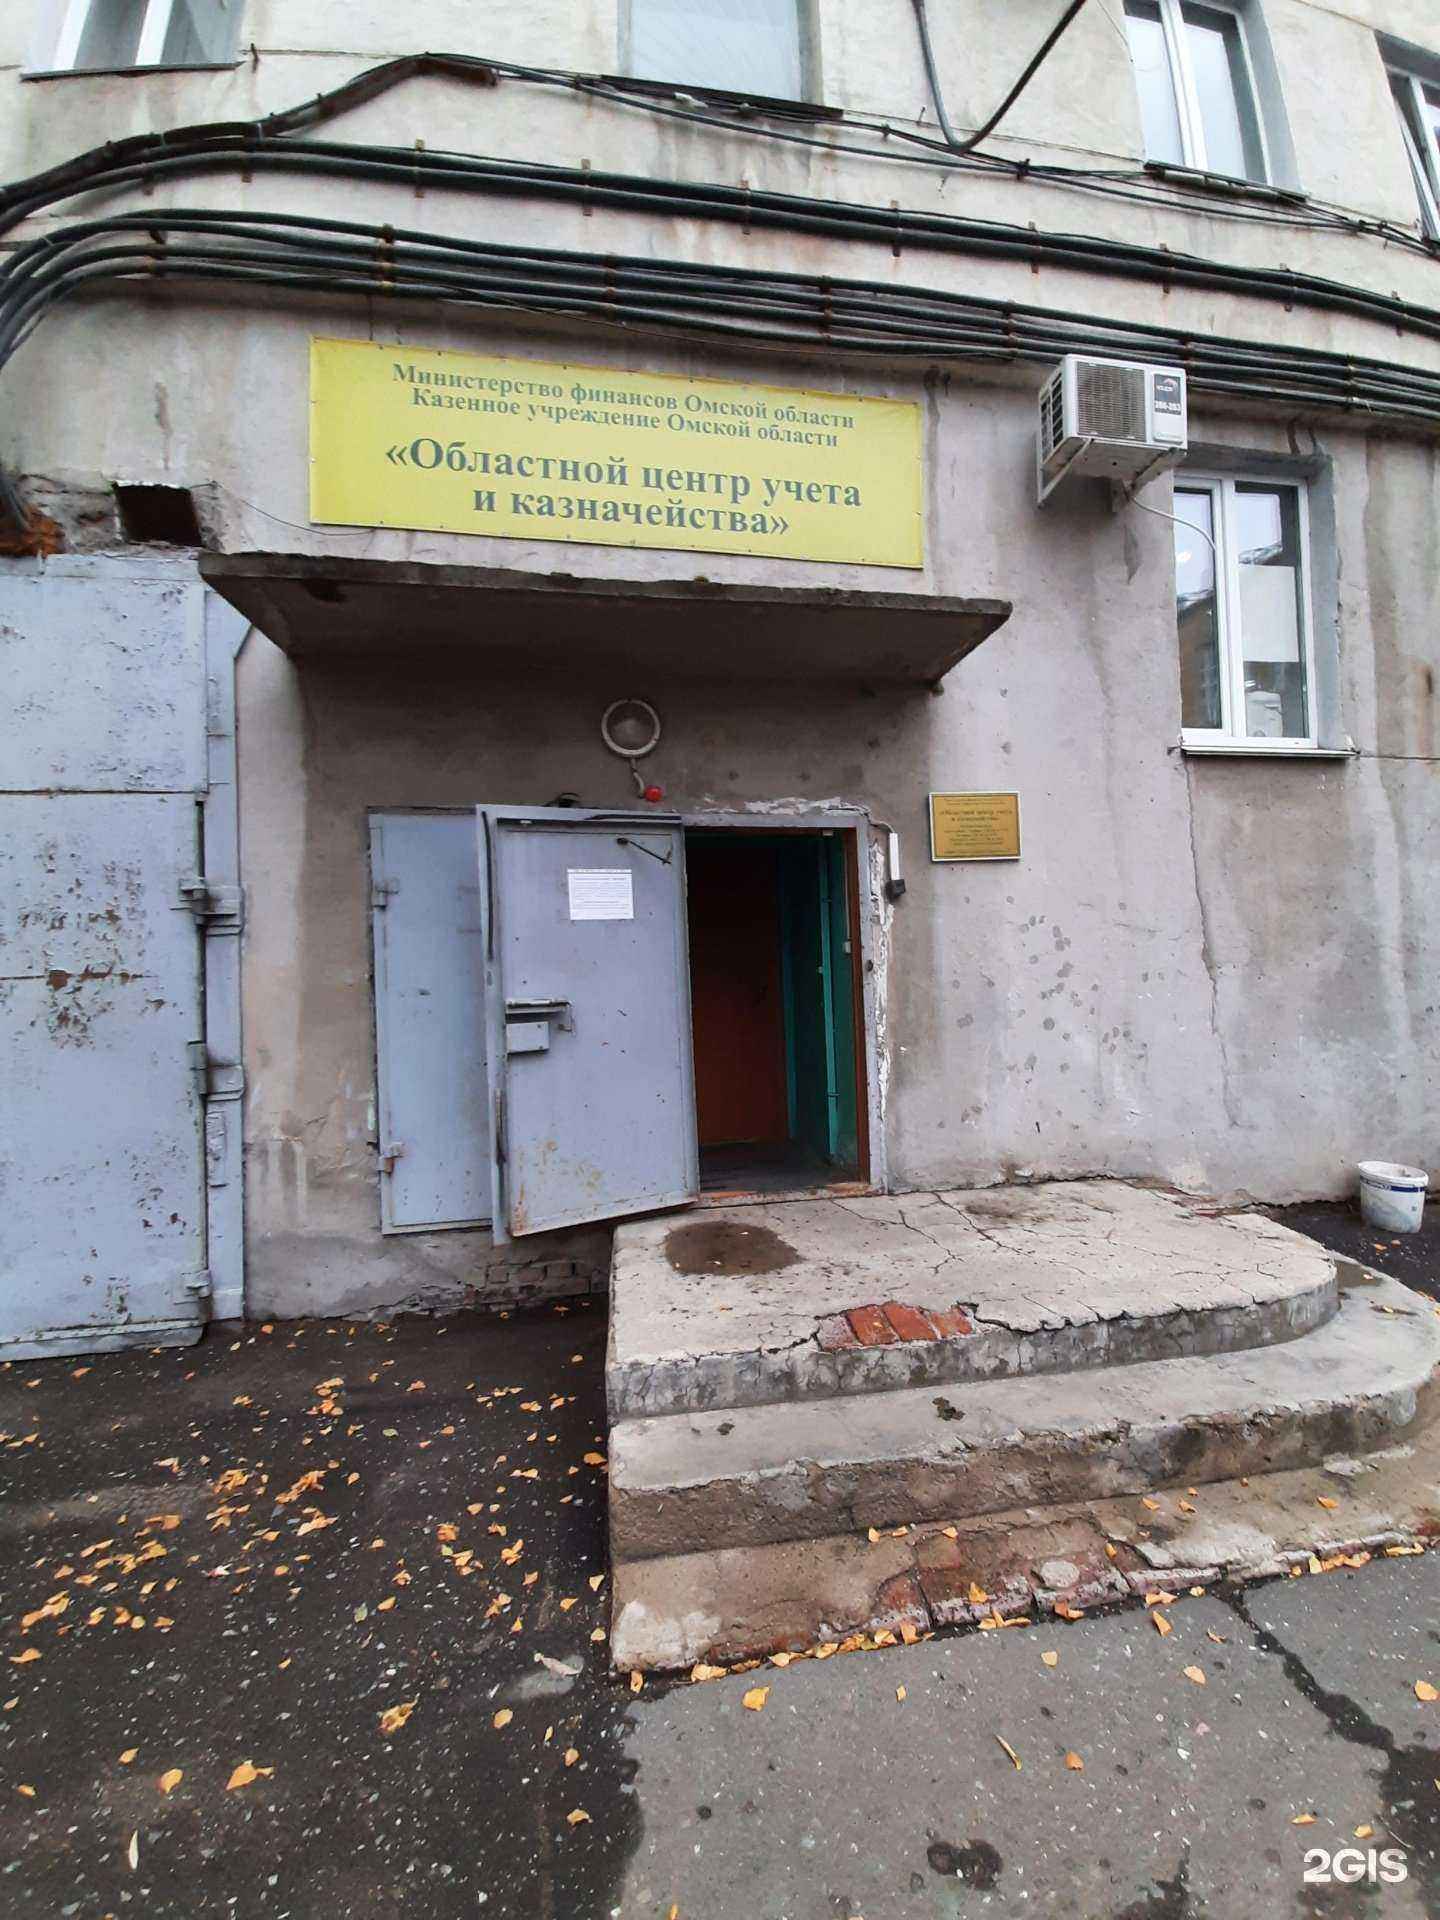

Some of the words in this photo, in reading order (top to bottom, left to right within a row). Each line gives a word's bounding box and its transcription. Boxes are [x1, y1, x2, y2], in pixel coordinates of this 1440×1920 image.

[393, 363, 563, 397] Министерство
[571, 383, 677, 410] финансов
[685, 394, 767, 419] Омской
[774, 405, 855, 428] области
[413, 387, 521, 415] Казенное
[528, 405, 660, 428] учреждение
[667, 413, 750, 437] Омской
[758, 424, 838, 447] области
[386, 438, 629, 486] «Областной
[642, 466, 750, 504] центр
[762, 477, 862, 507] учета
[473, 489, 497, 512] и
[511, 493, 789, 535] казначейства»
